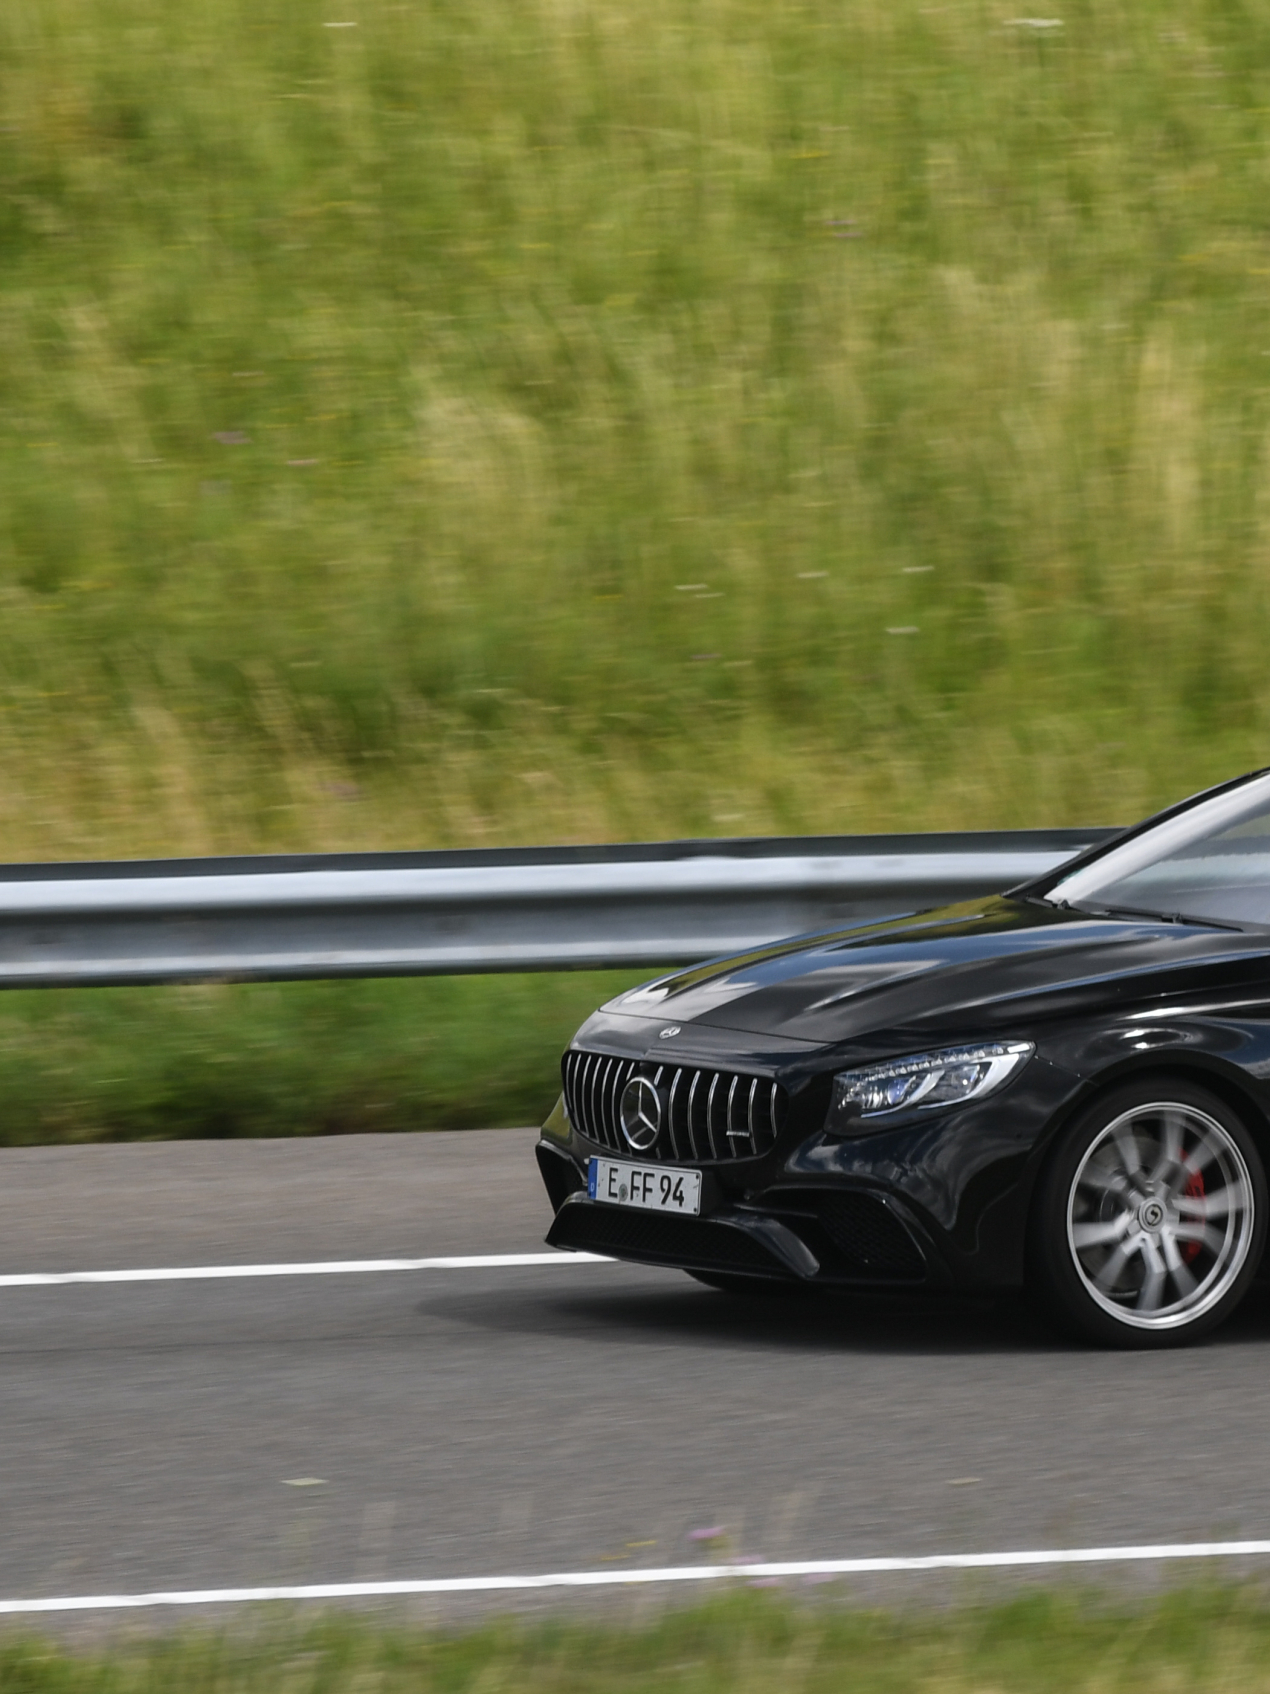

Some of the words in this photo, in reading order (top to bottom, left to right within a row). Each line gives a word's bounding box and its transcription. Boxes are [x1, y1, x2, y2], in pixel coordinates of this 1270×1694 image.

[607, 1167, 619, 1199] E
[630, 1171, 655, 1203] FF
[660, 1175, 685, 1208] 94
